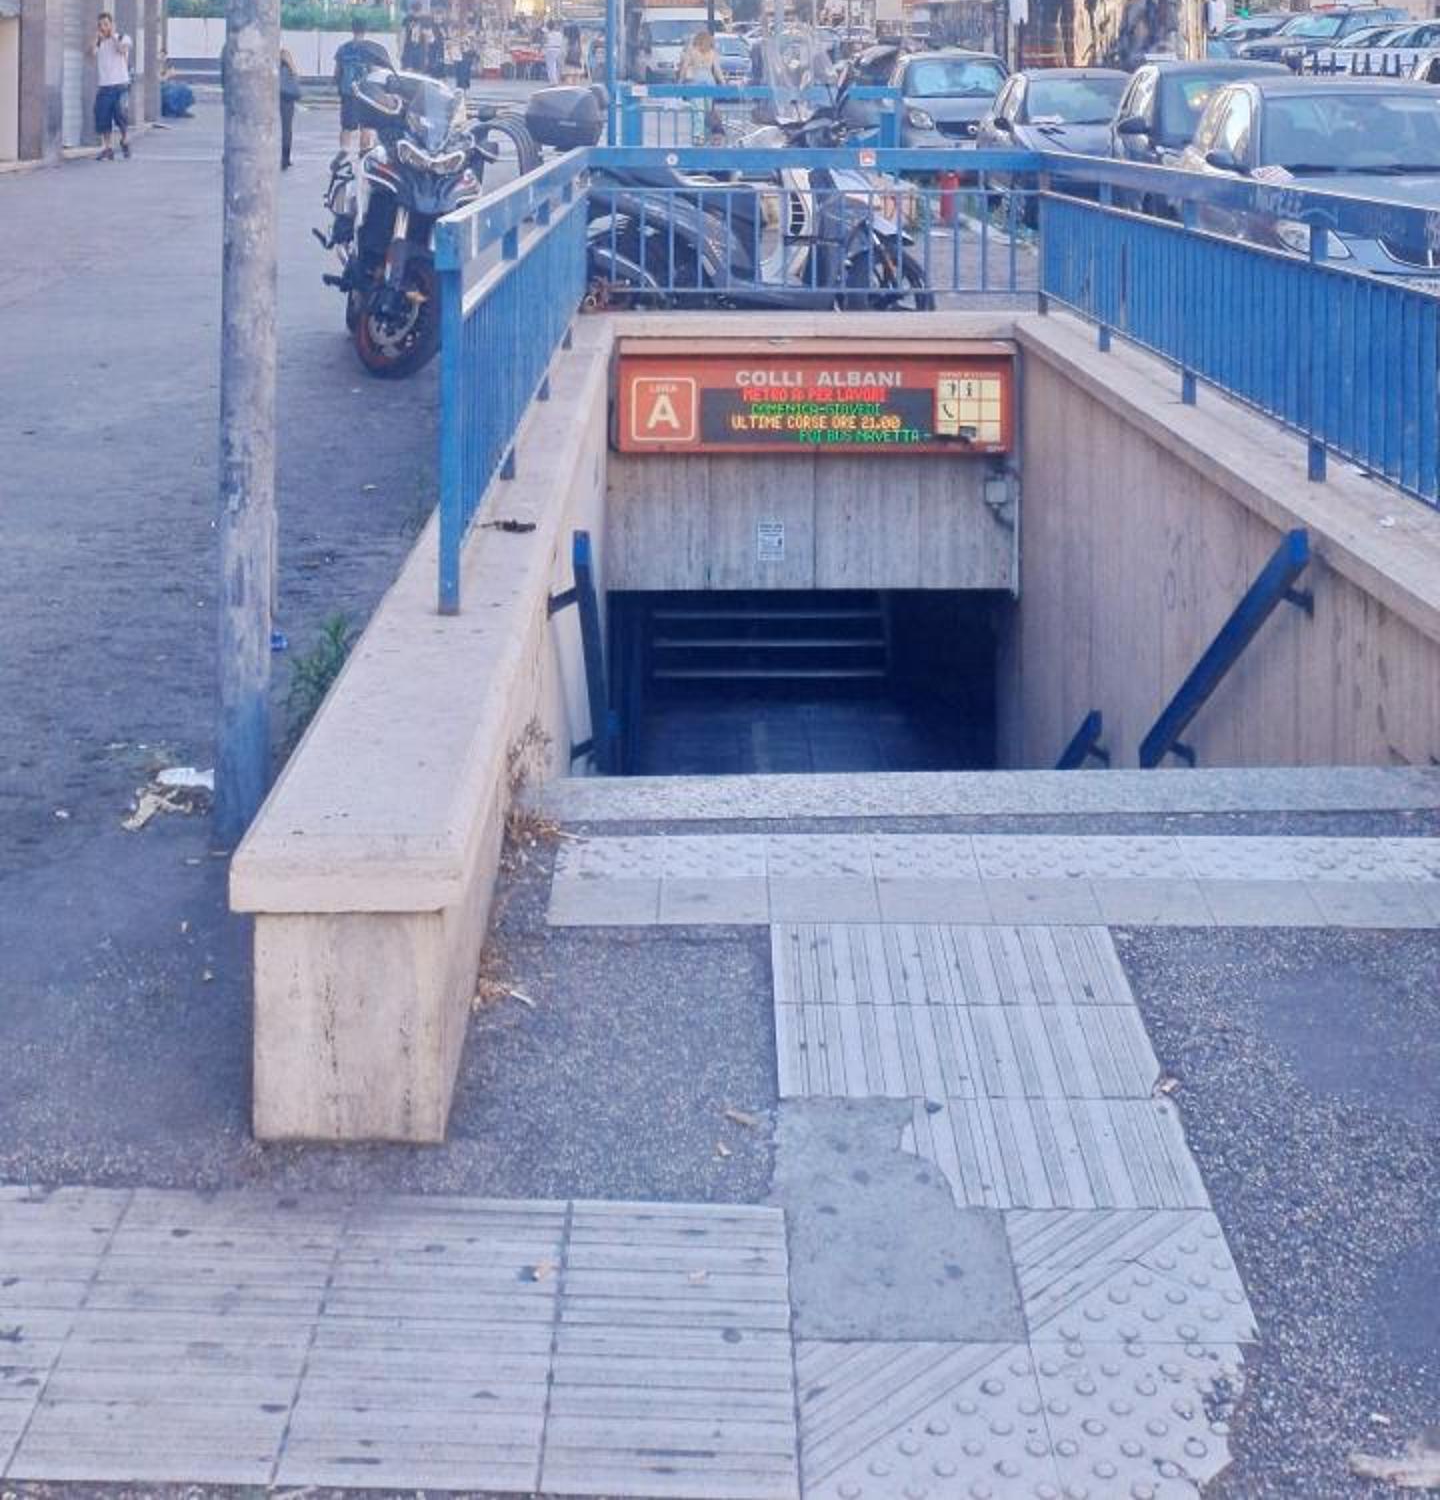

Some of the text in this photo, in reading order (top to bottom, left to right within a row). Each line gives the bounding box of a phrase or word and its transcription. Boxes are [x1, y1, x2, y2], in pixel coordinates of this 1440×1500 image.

[735, 370, 902, 386] COLLI ALBANI
[743, 387, 788, 402] METRO
[808, 387, 833, 402] PER
[837, 387, 886, 402] LAVORI
[647, 394, 681, 429] A
[731, 415, 901, 430] ULTIME CORSE ORE 21.00
[827, 429, 852, 443] BUS
[856, 429, 919, 443] NAVETTA
